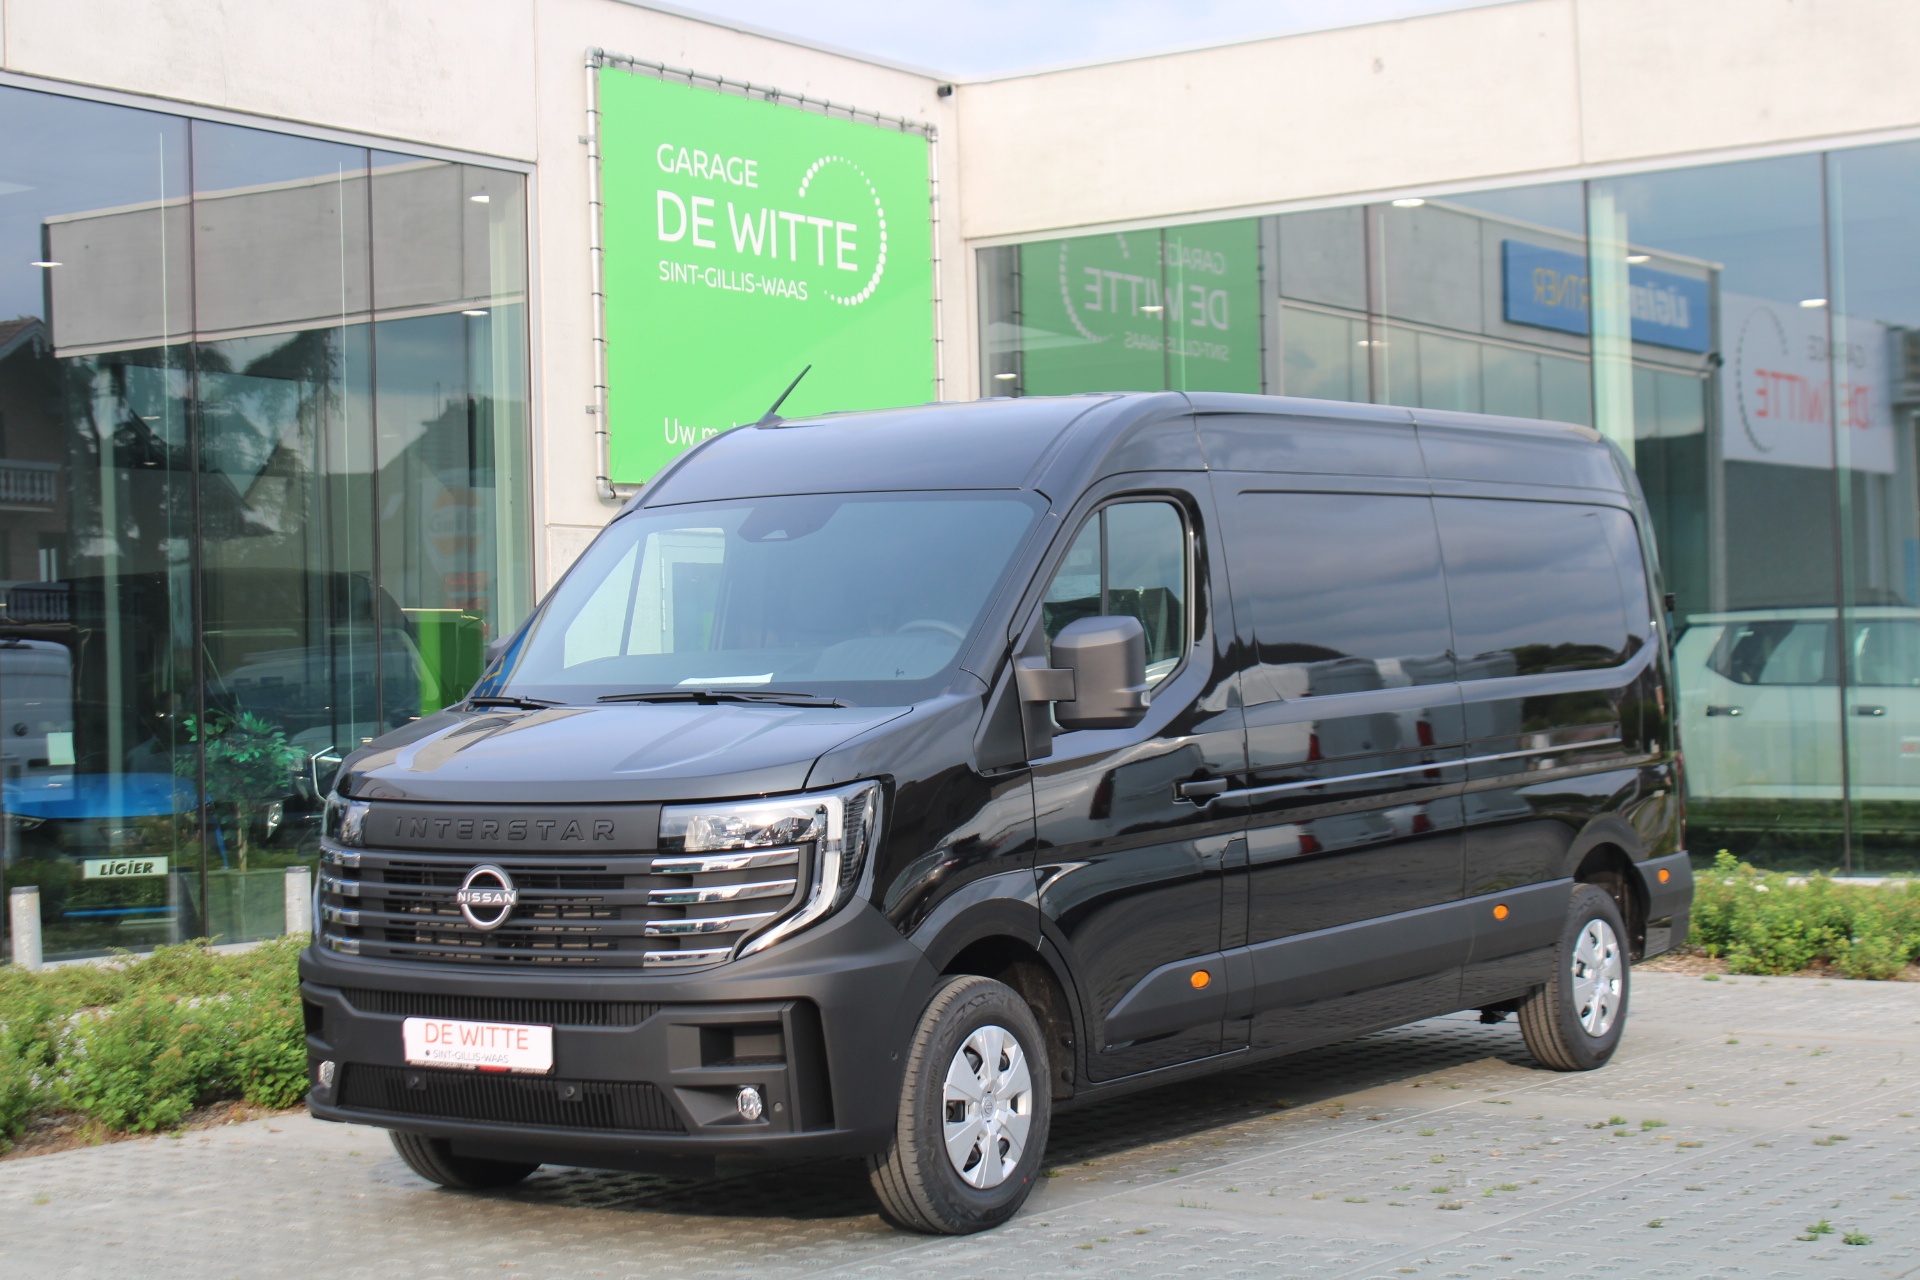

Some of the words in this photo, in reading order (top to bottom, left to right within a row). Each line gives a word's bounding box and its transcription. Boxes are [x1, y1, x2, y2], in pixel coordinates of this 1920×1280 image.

[657, 143, 759, 188] GARAGE
[656, 189, 716, 249] DE
[727, 201, 858, 272] WITTE
[659, 260, 808, 301] SINT-GILLIS-WAAS
[664, 417, 697, 446] Uw
[394, 816, 615, 841] INTERSTAR
[457, 891, 515, 903] NISSAN
[425, 1022, 453, 1045] DE
[459, 1024, 529, 1050] WITTE
[433, 1049, 509, 1064] SINT-GILLIS-WAAS
